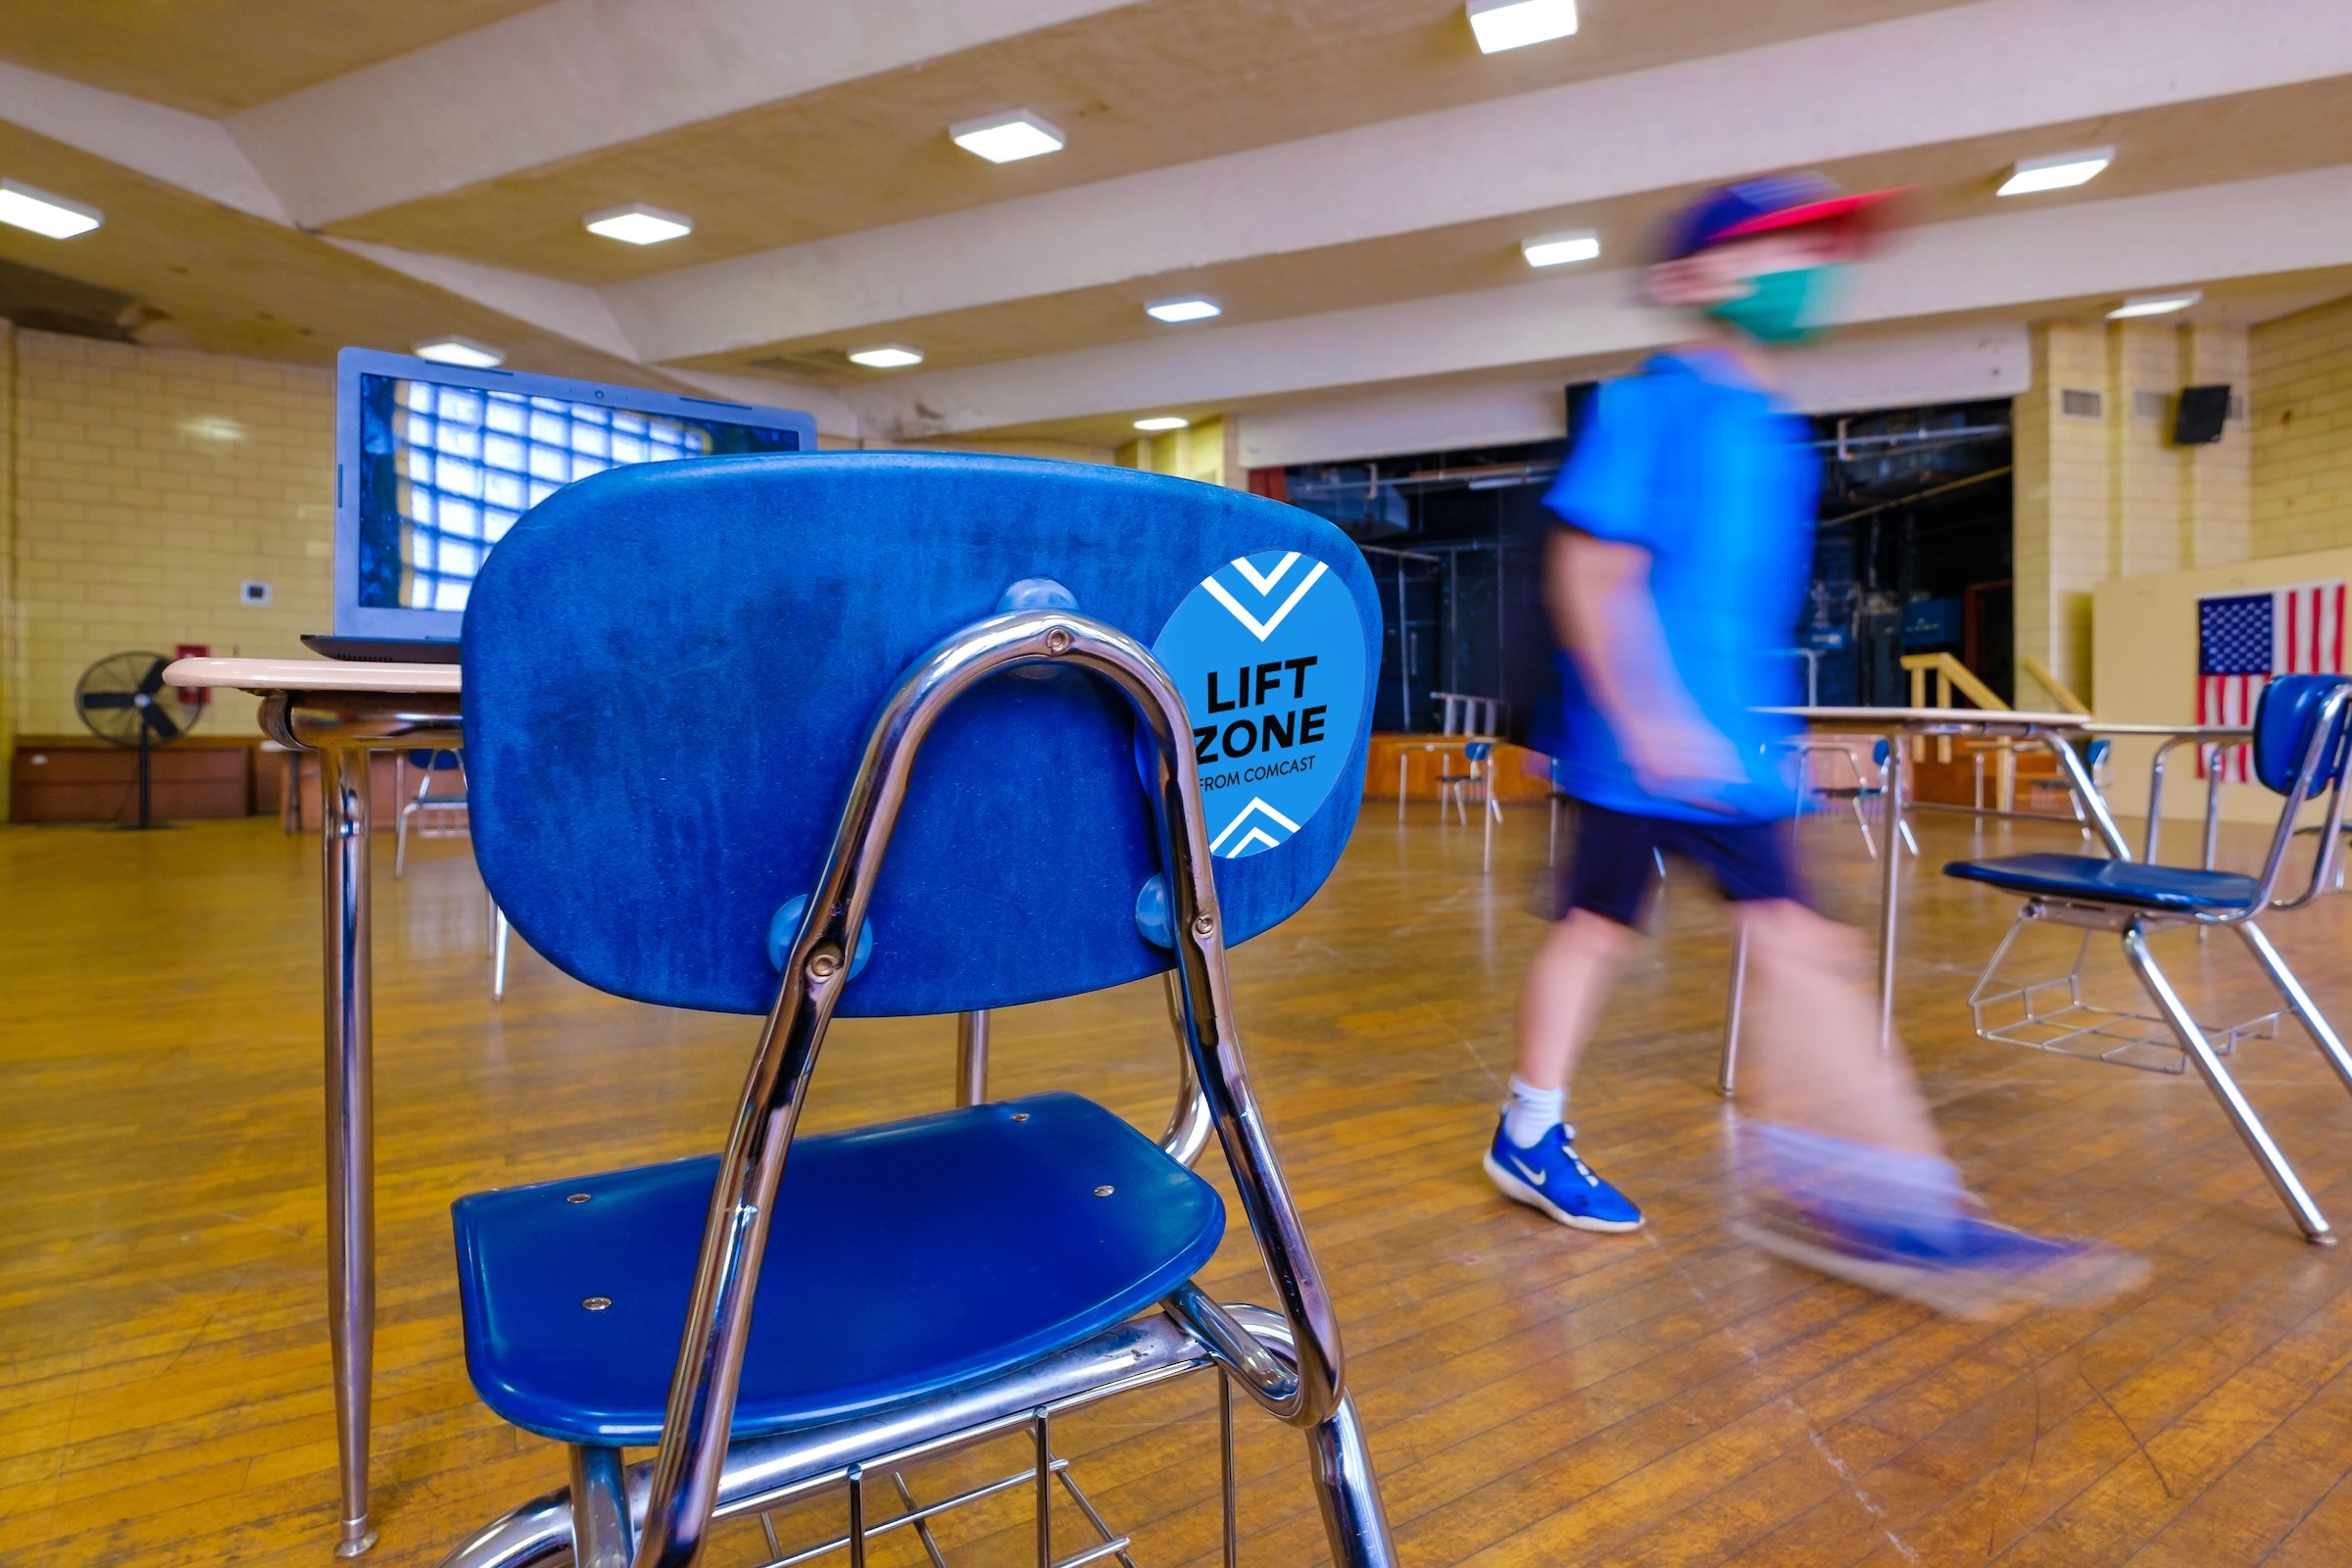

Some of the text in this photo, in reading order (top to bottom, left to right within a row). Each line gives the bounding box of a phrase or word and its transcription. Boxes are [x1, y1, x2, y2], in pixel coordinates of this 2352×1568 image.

[1207, 656, 1318, 713] LIFT
[1193, 705, 1327, 765] ZONE
[1244, 756, 1316, 783] COMCAST
